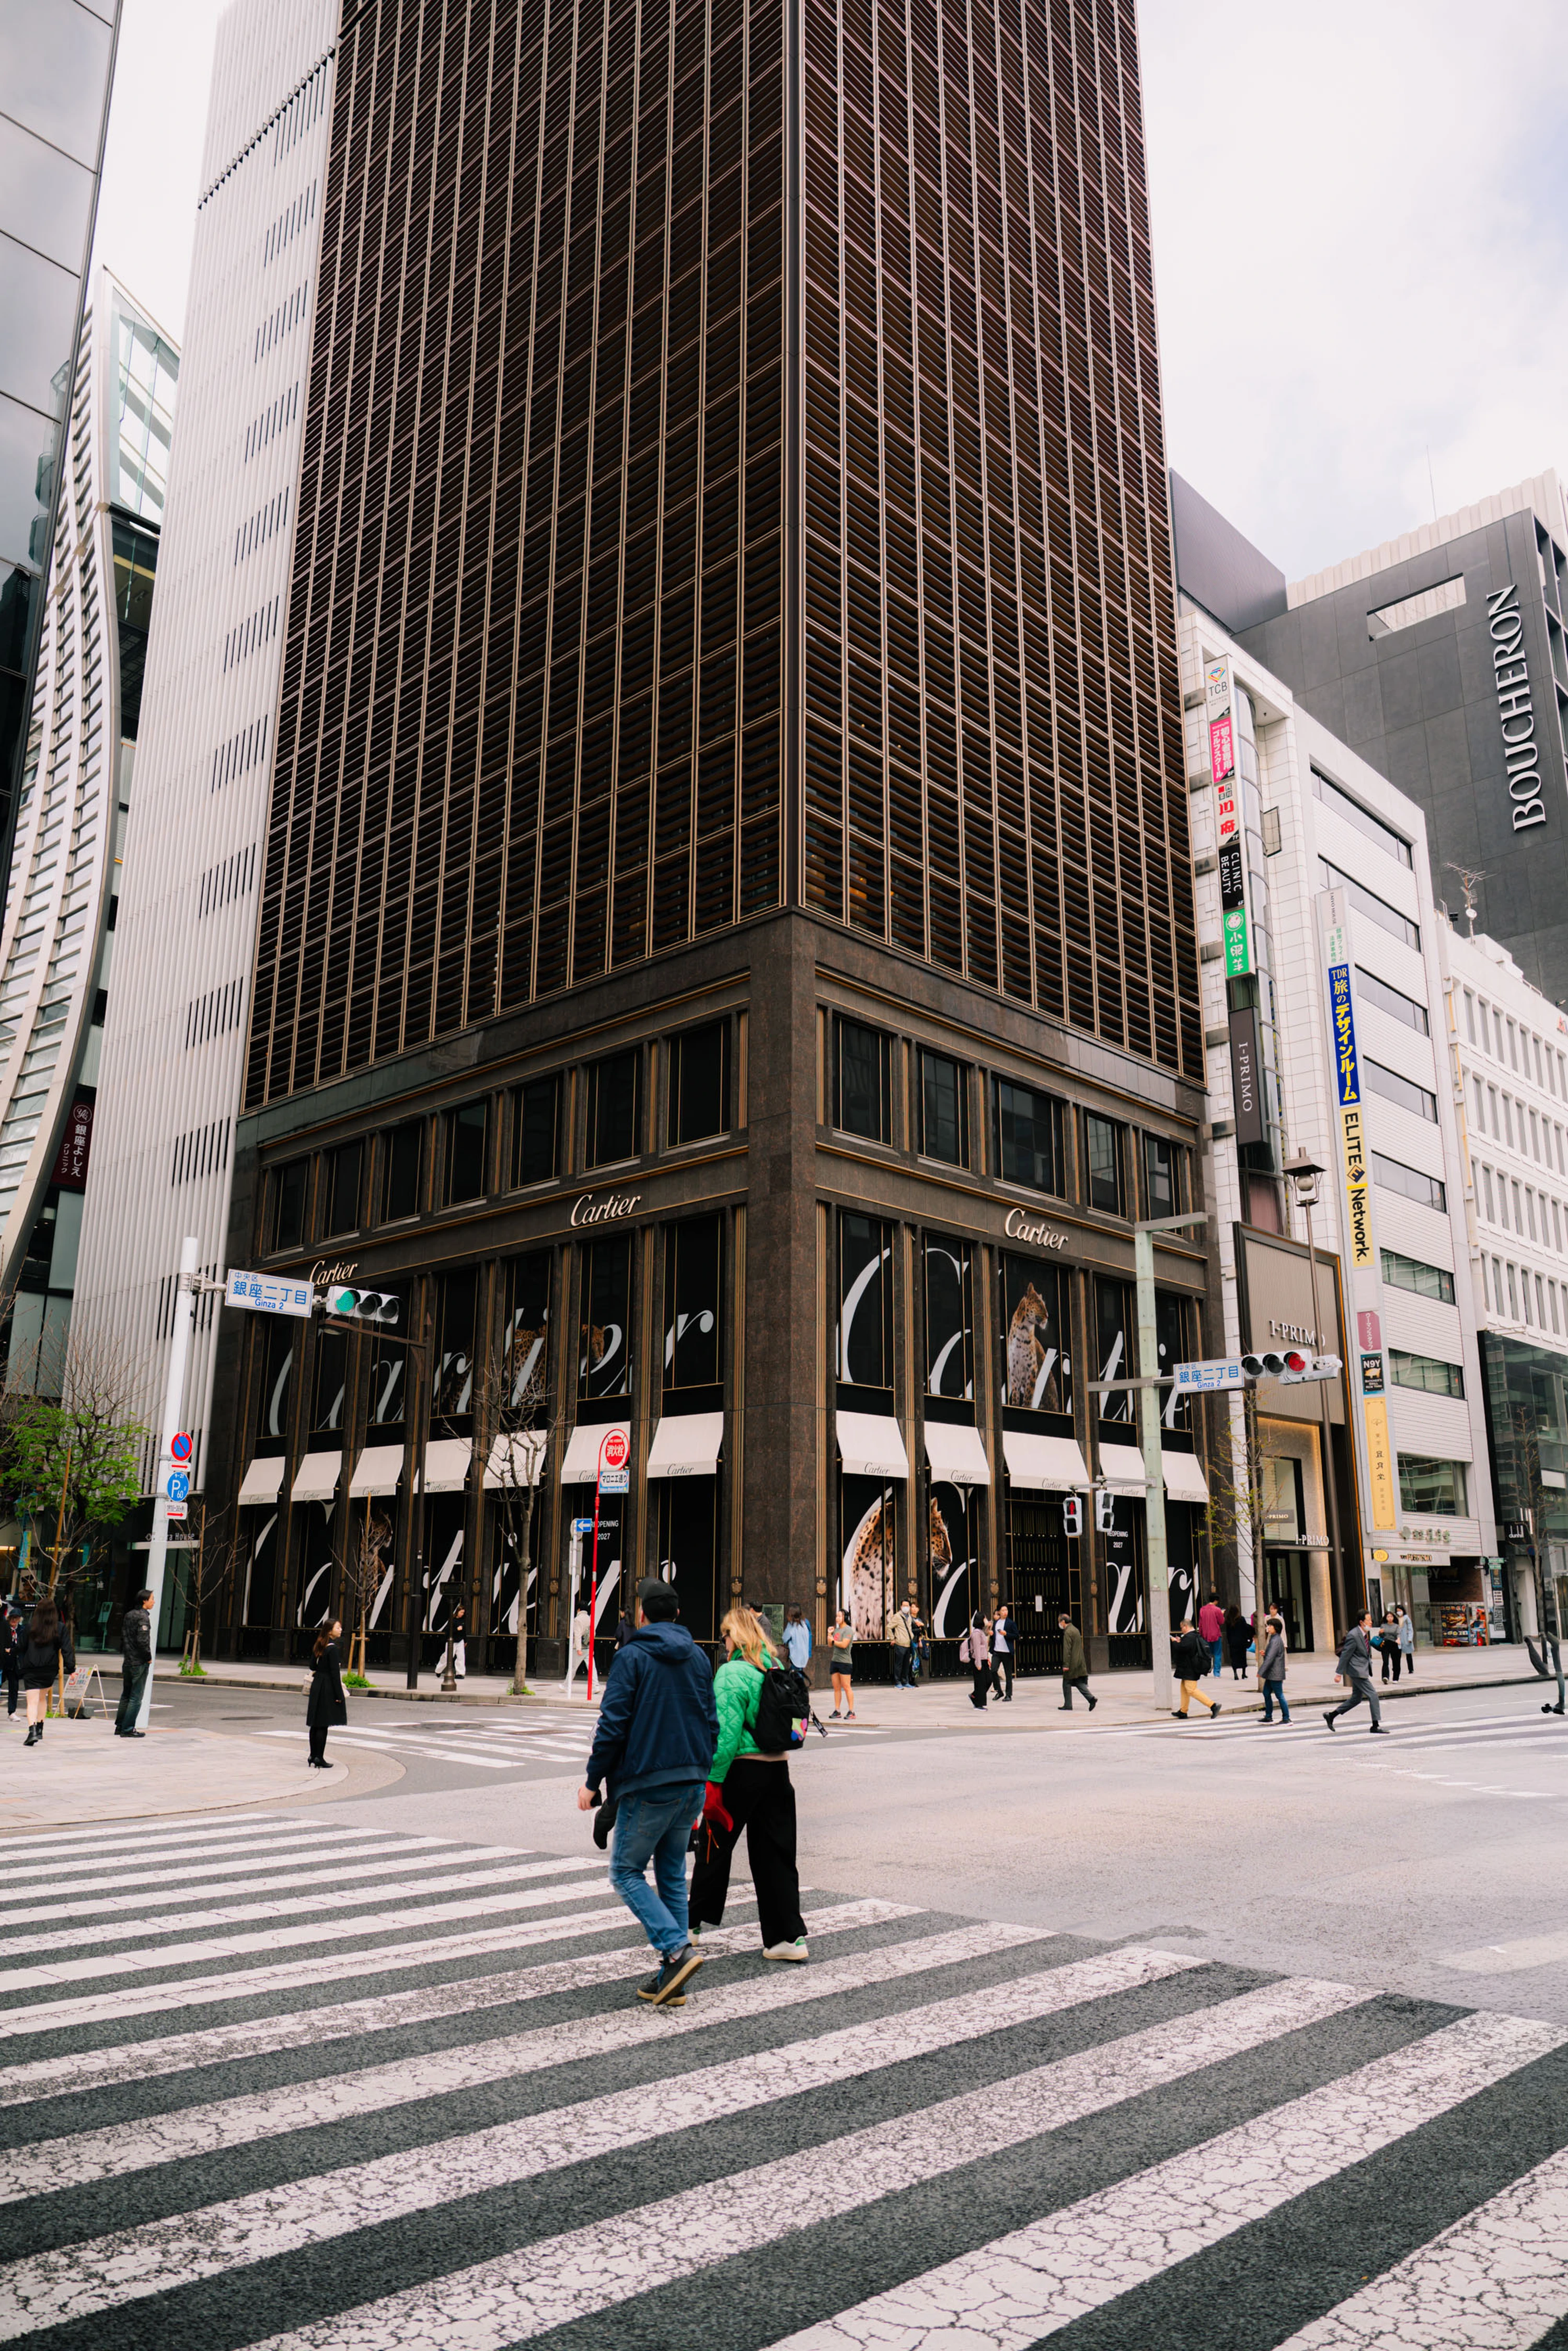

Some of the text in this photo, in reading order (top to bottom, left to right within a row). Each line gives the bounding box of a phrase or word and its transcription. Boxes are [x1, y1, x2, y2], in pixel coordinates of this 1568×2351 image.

[1208, 681, 1227, 696] TCB
[1486, 584, 1547, 831] BOUCHERON
[1213, 729, 1224, 778] ゴルフスクール
[1220, 855, 1231, 893] BEAUTY
[1231, 852, 1242, 892] CLINIC
[1331, 968, 1358, 1102] TDR 旅のデザインルーム
[1239, 1041, 1253, 1112] I-PRIMO
[1345, 1113, 1362, 1166] ELITE
[61, 1143, 70, 1173] クリニック
[71, 1124, 87, 1177] 銀座よしえ
[571, 1194, 641, 1226] Cartier
[1005, 1208, 1068, 1250] Cartier
[1351, 1188, 1370, 1261] Network.
[235, 1272, 259, 1281] 中央区
[309, 1260, 359, 1286] Cartier
[233, 1280, 307, 1305] 銀座二丁目
[255, 1298, 284, 1310] Ginza 2
[1179, 1365, 1239, 1383] 銀座二丁目
[1363, 1360, 1380, 1369] N9Y
[606, 1444, 624, 1457] 消火栓
[579, 1470, 598, 1482] Cartie
[667, 1464, 695, 1475] Cartier
[863, 1462, 890, 1475] Cartier
[951, 1470, 974, 1482] Cartier
[171, 1480, 181, 1498] P
[1042, 1478, 1062, 1489] Cartier
[1295, 1534, 1329, 1546] I-PRIMO
[1508, 1525, 1524, 1538] dunhill
